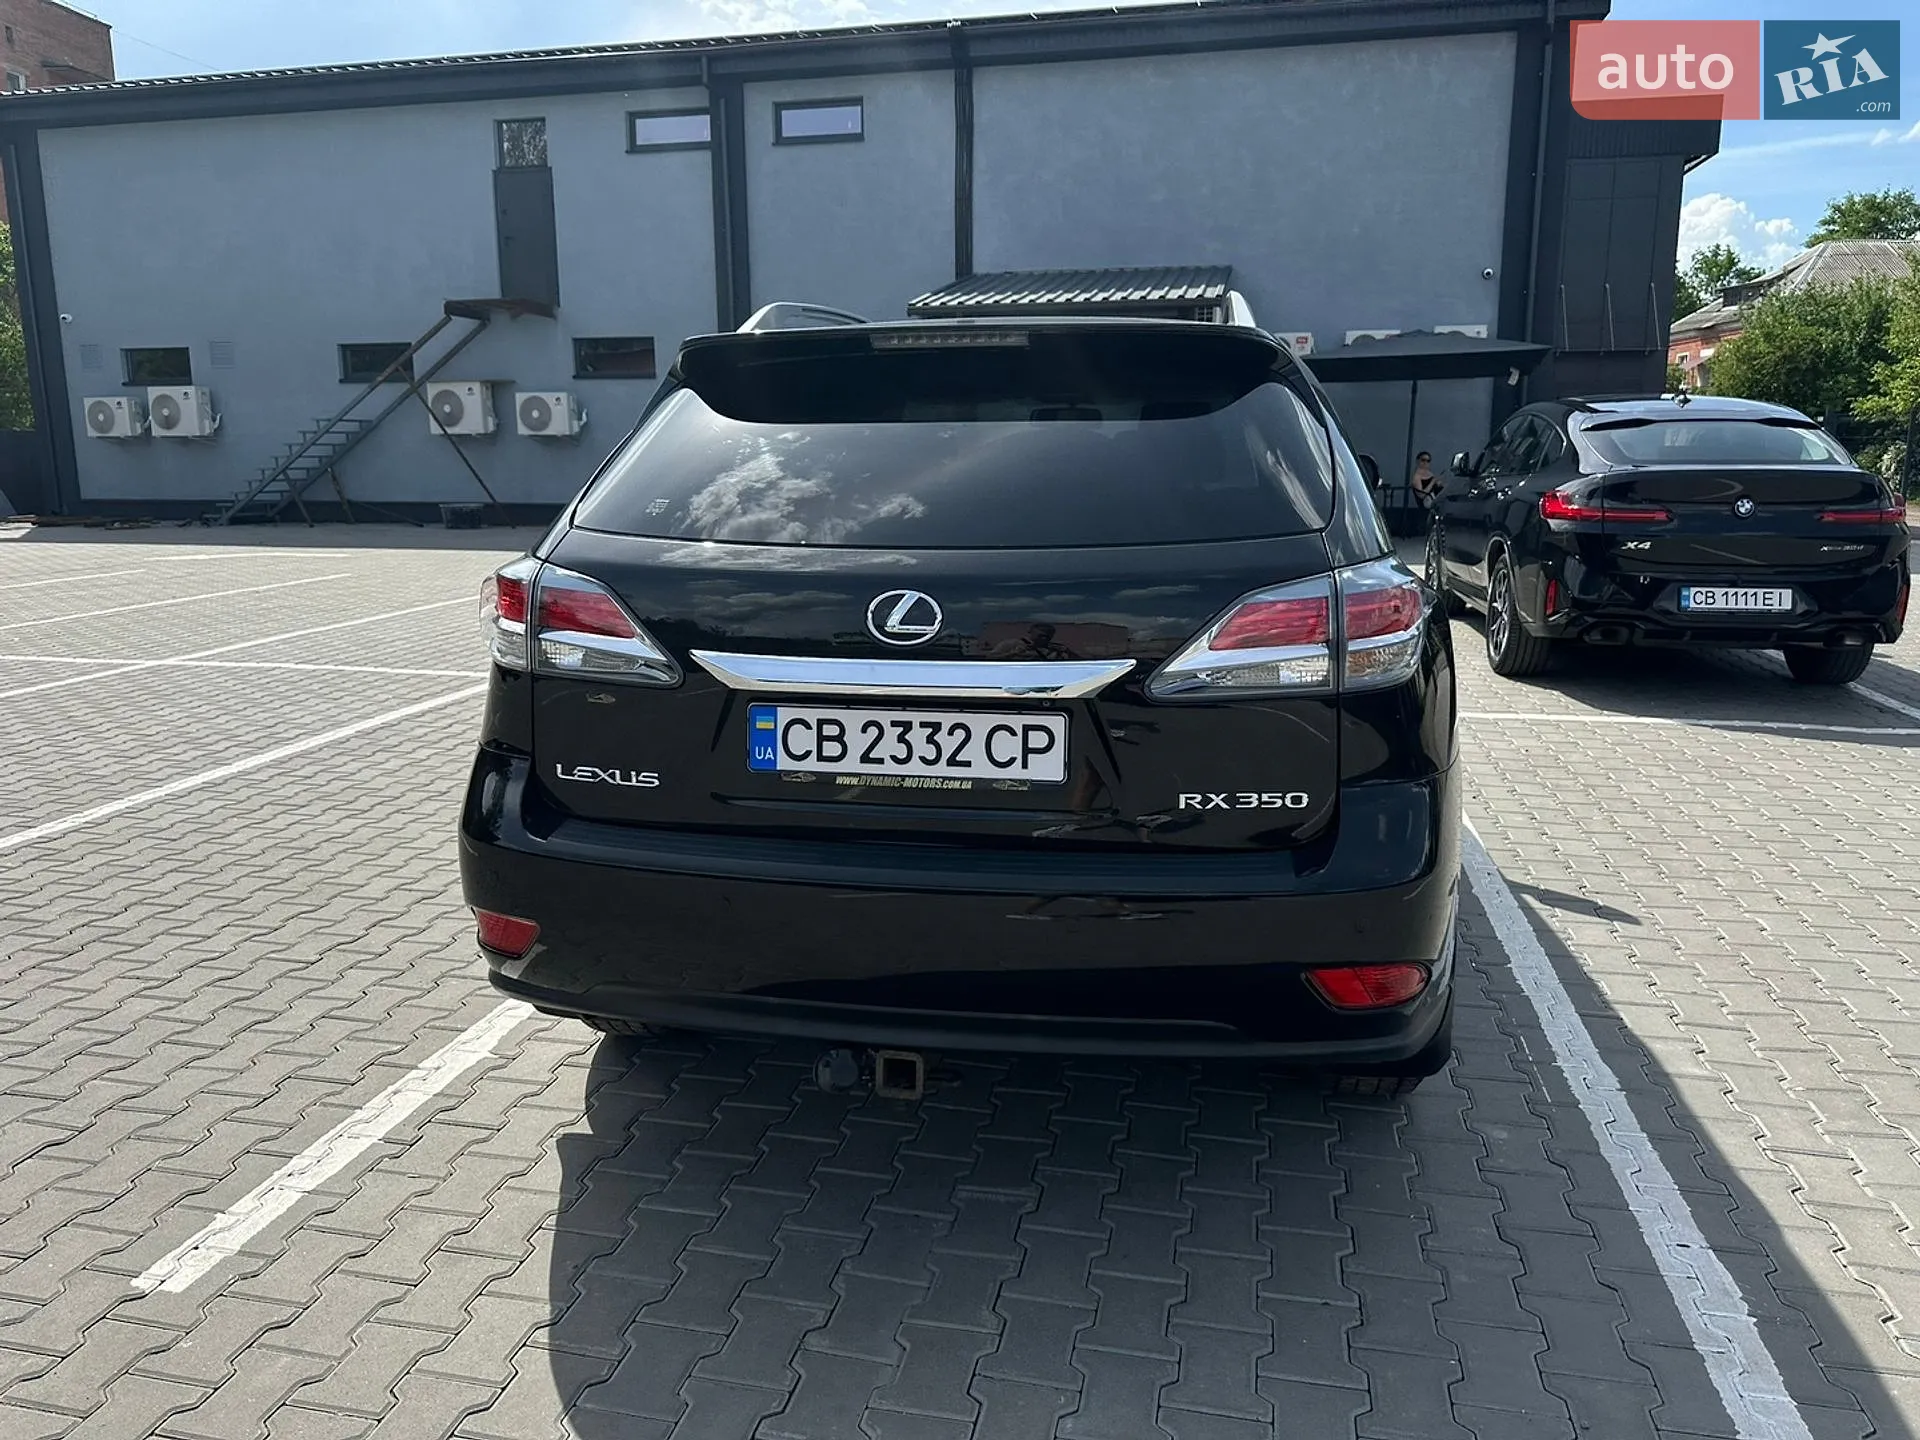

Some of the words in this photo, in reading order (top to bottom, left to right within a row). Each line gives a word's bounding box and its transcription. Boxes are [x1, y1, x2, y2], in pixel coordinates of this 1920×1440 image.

[1620, 541, 1652, 550] X4
[1693, 590, 1716, 606] CB
[1721, 591, 1758, 606] 1111
[1763, 591, 1783, 607] EI
[781, 717, 849, 764] CB
[859, 719, 973, 768] 2332
[984, 724, 1056, 770] CP
[755, 746, 775, 760] UA
[556, 763, 660, 787] LEXUS
[1178, 793, 1231, 809] RX
[1235, 792, 1309, 808] 350
